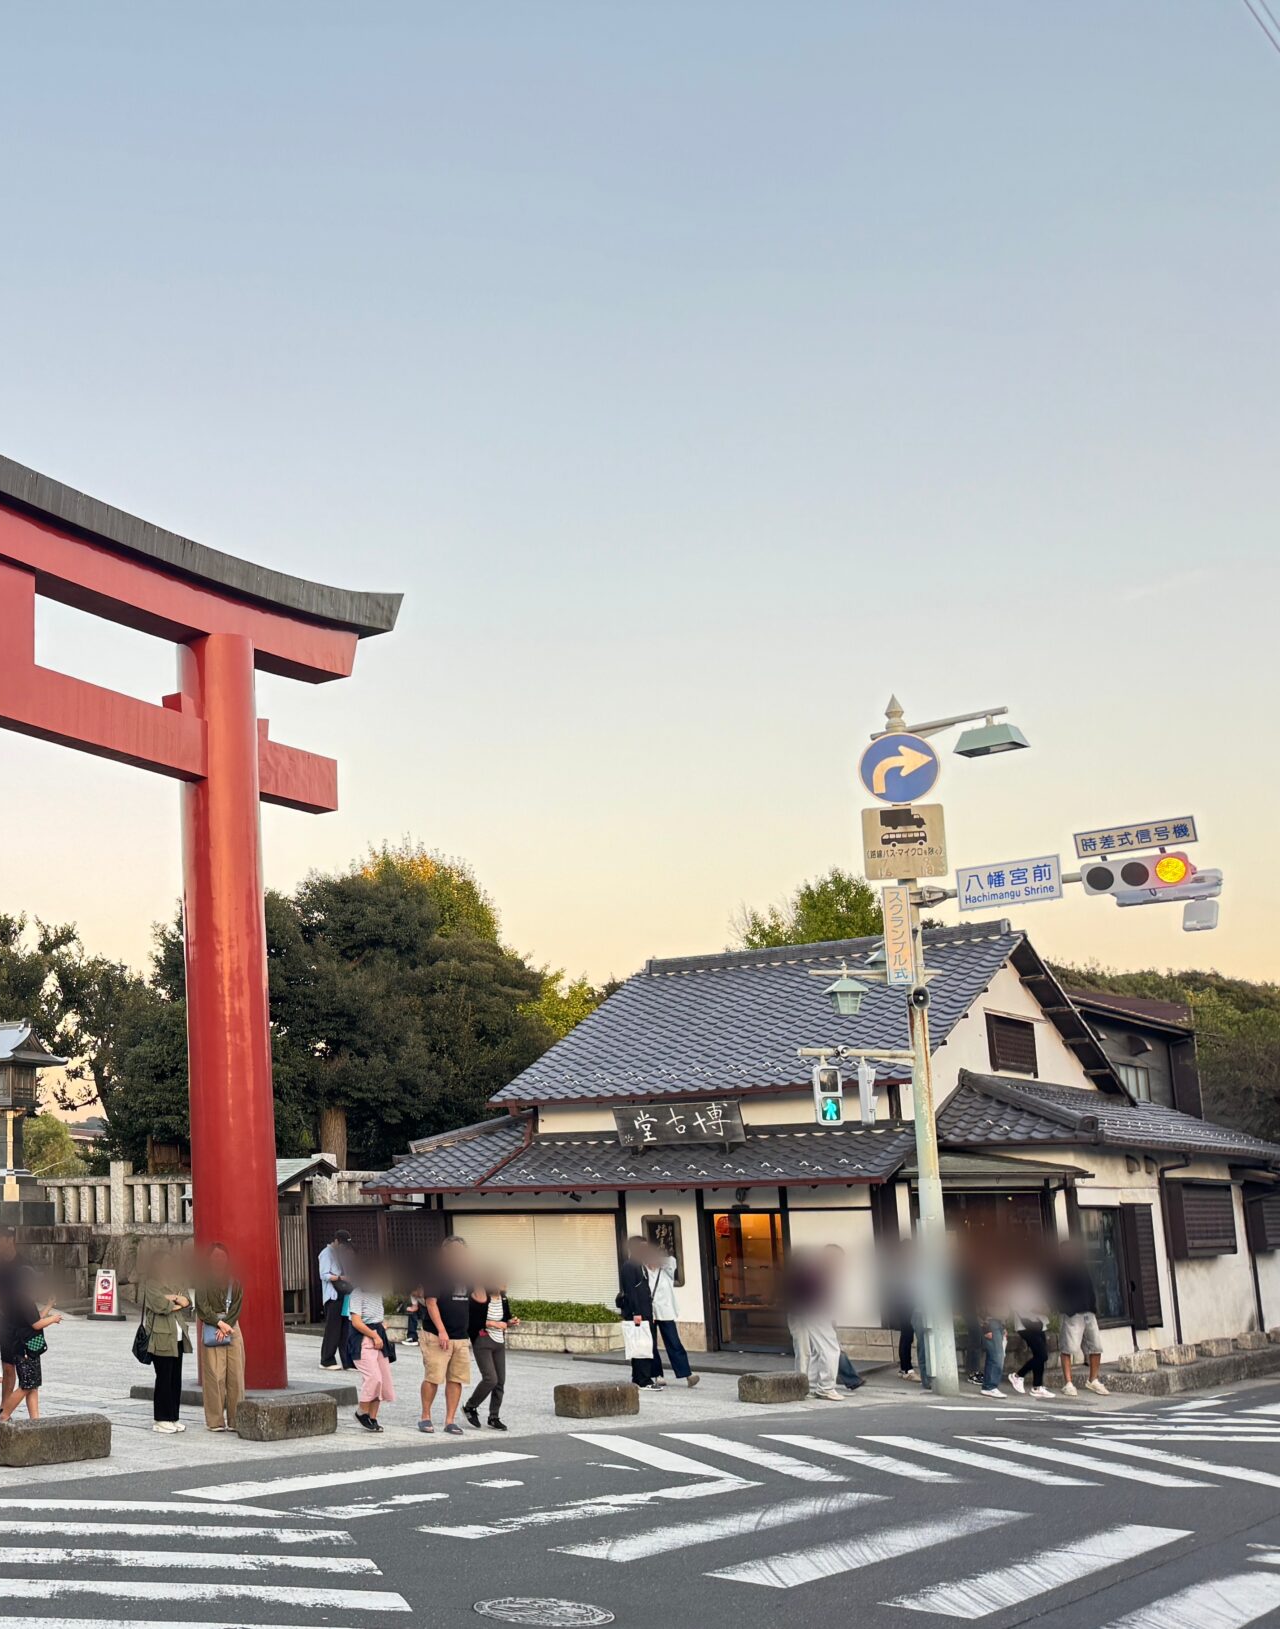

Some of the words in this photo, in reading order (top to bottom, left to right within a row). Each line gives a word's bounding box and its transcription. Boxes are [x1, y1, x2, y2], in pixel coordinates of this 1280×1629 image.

[1081, 823, 1190, 852] 時差式信号機
[965, 864, 1052, 892] 八幡宮前
[965, 890, 1021, 904] Hachimangu
[1024, 885, 1055, 896] Shrine
[889, 891, 908, 979] スクランブル式
